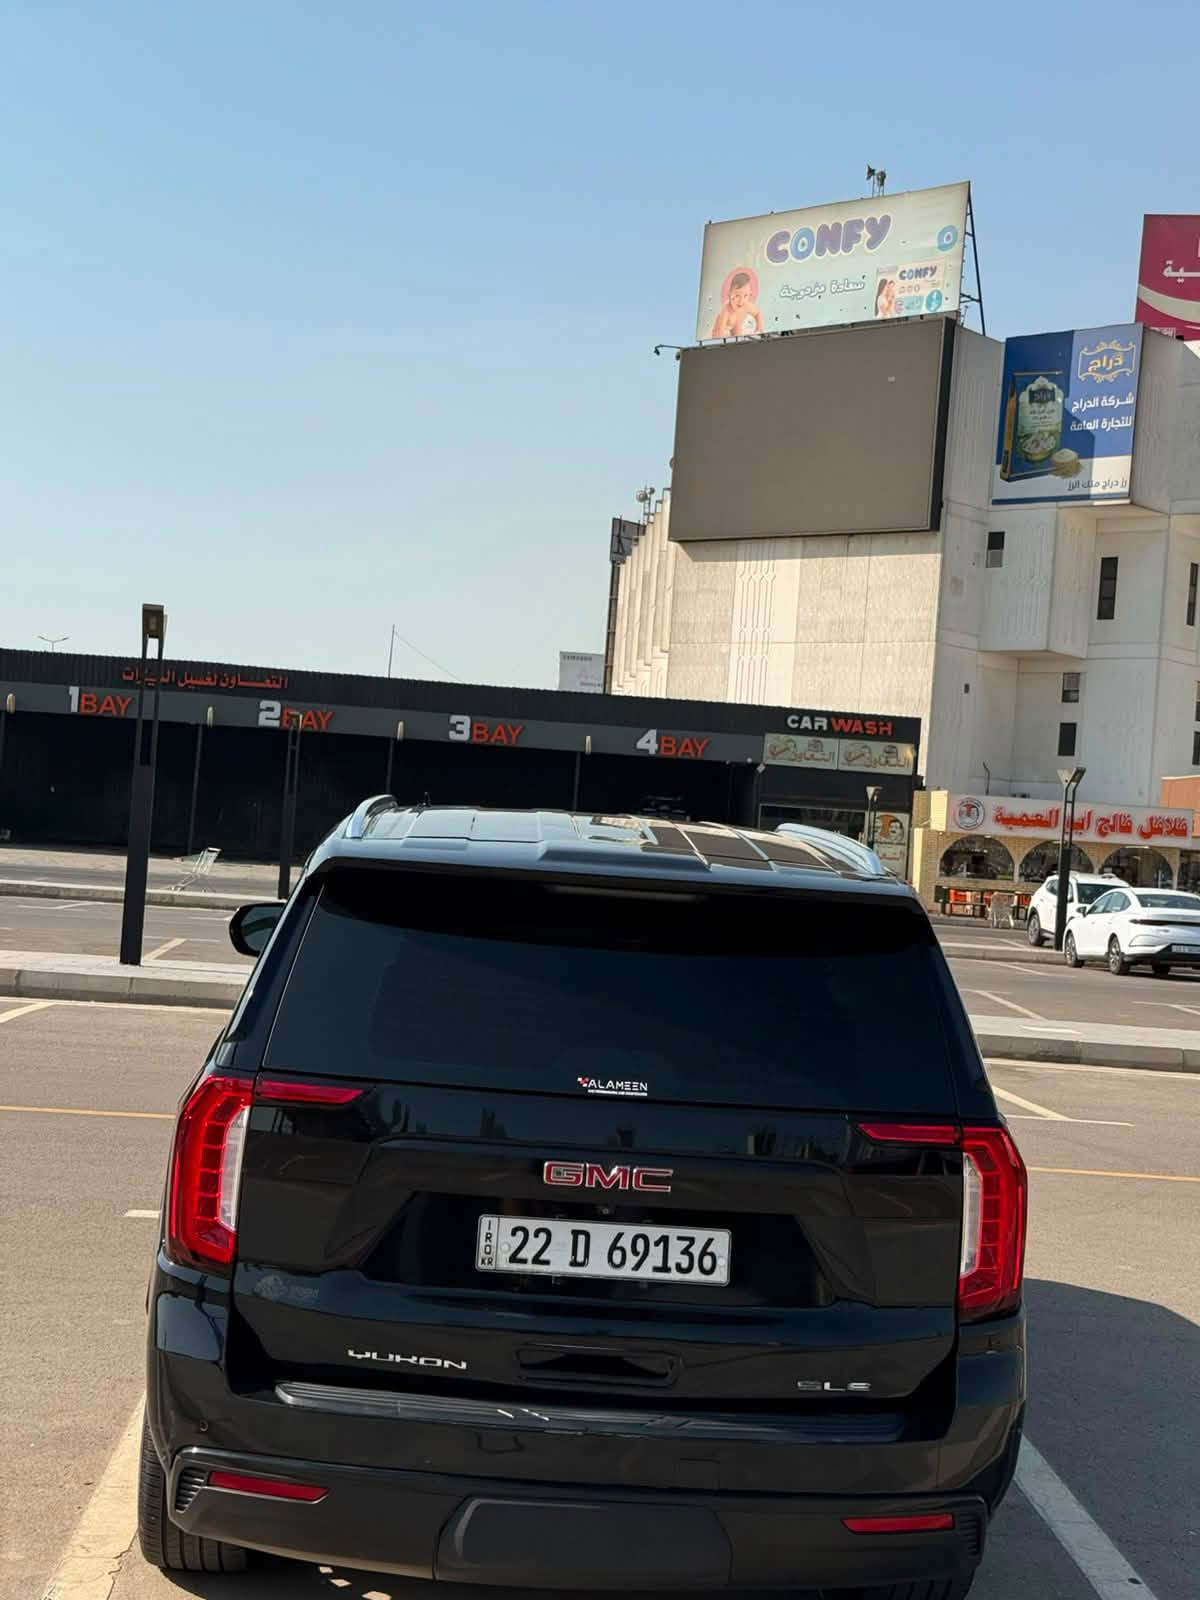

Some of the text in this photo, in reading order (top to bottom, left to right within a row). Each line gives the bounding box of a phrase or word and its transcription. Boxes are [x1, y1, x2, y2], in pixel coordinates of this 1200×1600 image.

[766, 214, 892, 263] CONFY
[899, 265, 937, 280] CONFY
[831, 278, 865, 295] سعادة
[1101, 392, 1134, 408] شركة
[1070, 416, 1132, 431] للتجارة العامة
[177, 670, 218, 688] لغسيل
[787, 715, 895, 736] CAR WASH
[588, 1079, 648, 1091] ALAMEEN
[544, 1161, 673, 1192] GMC
[508, 1225, 717, 1276] 22 D 69136
[348, 1349, 467, 1370] YUKON
